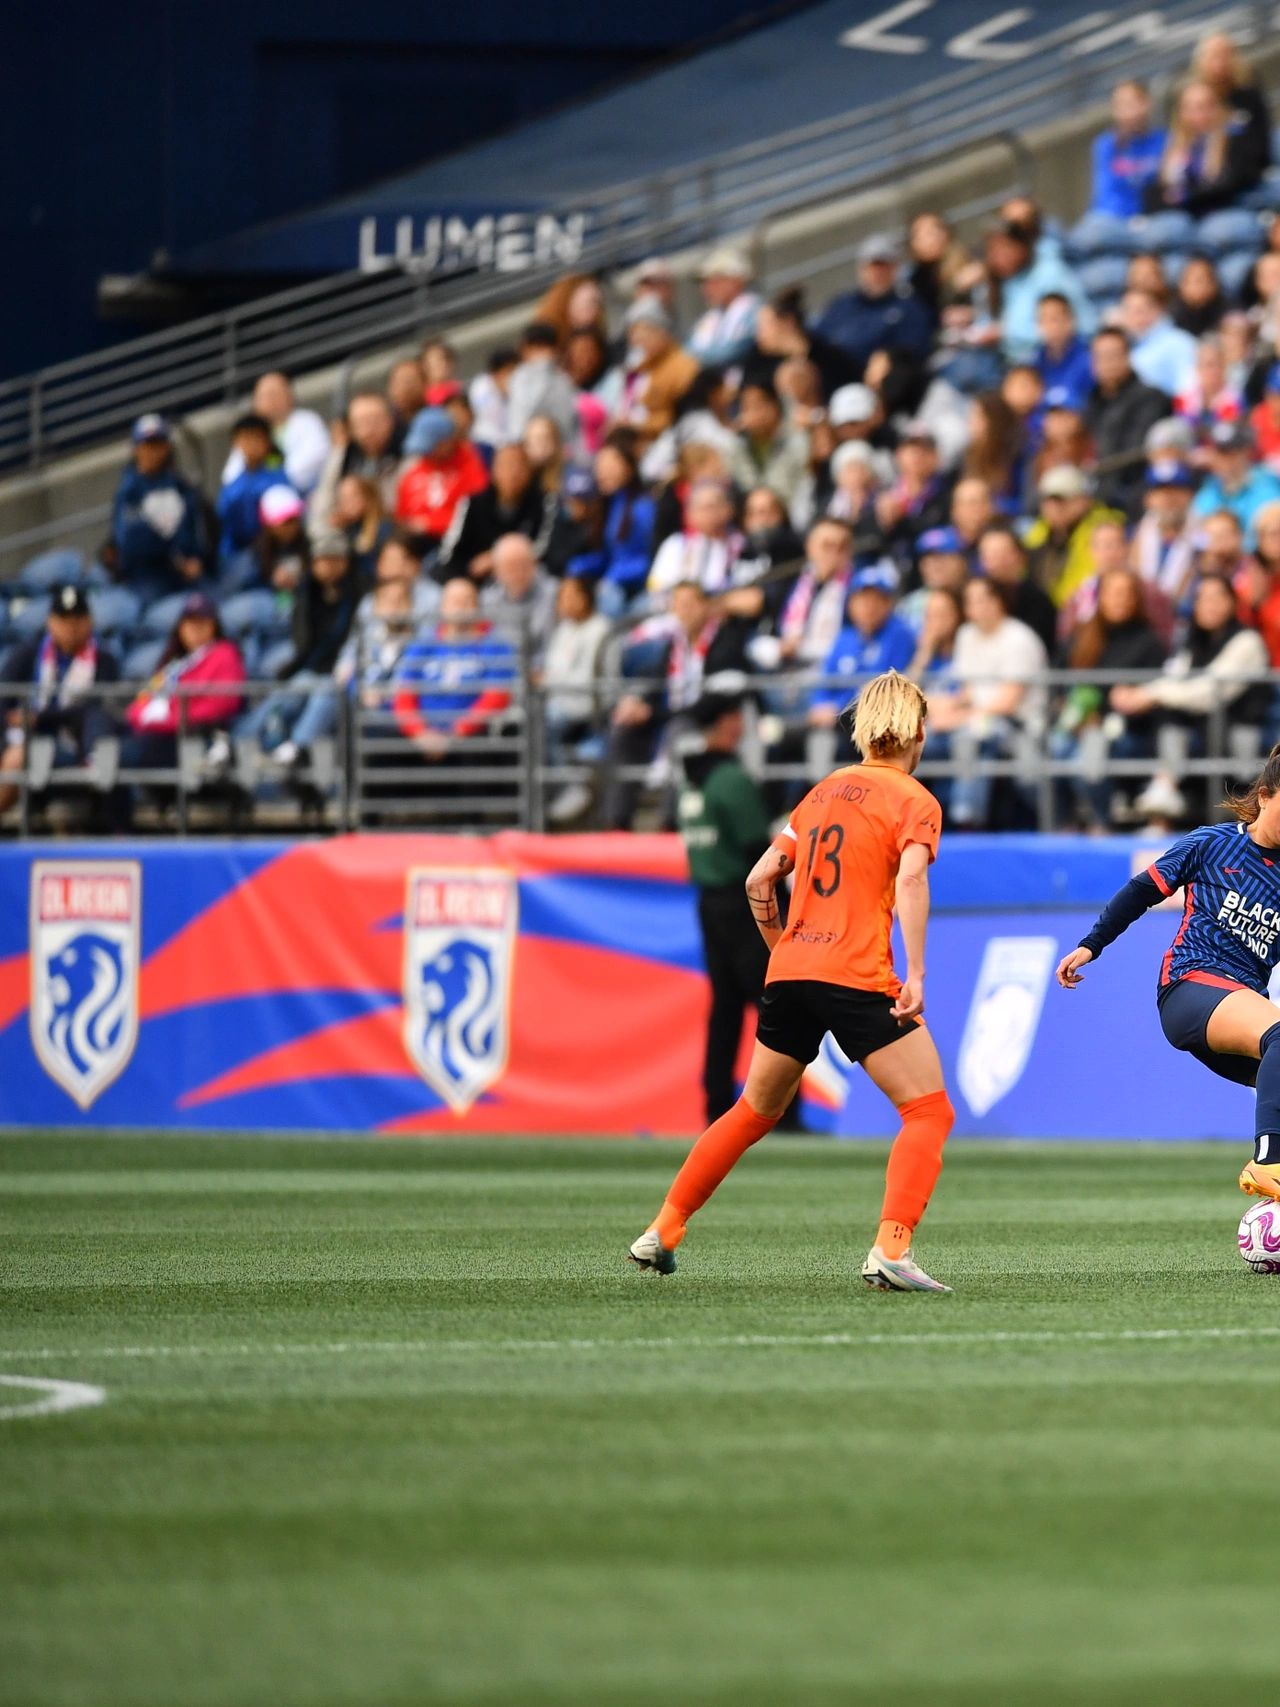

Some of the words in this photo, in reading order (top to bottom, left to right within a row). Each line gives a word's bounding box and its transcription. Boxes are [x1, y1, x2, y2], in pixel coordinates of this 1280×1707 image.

[359, 212, 583, 275] LUMEN
[806, 823, 844, 898] 13
[1217, 907, 1278, 944] FUTURE
